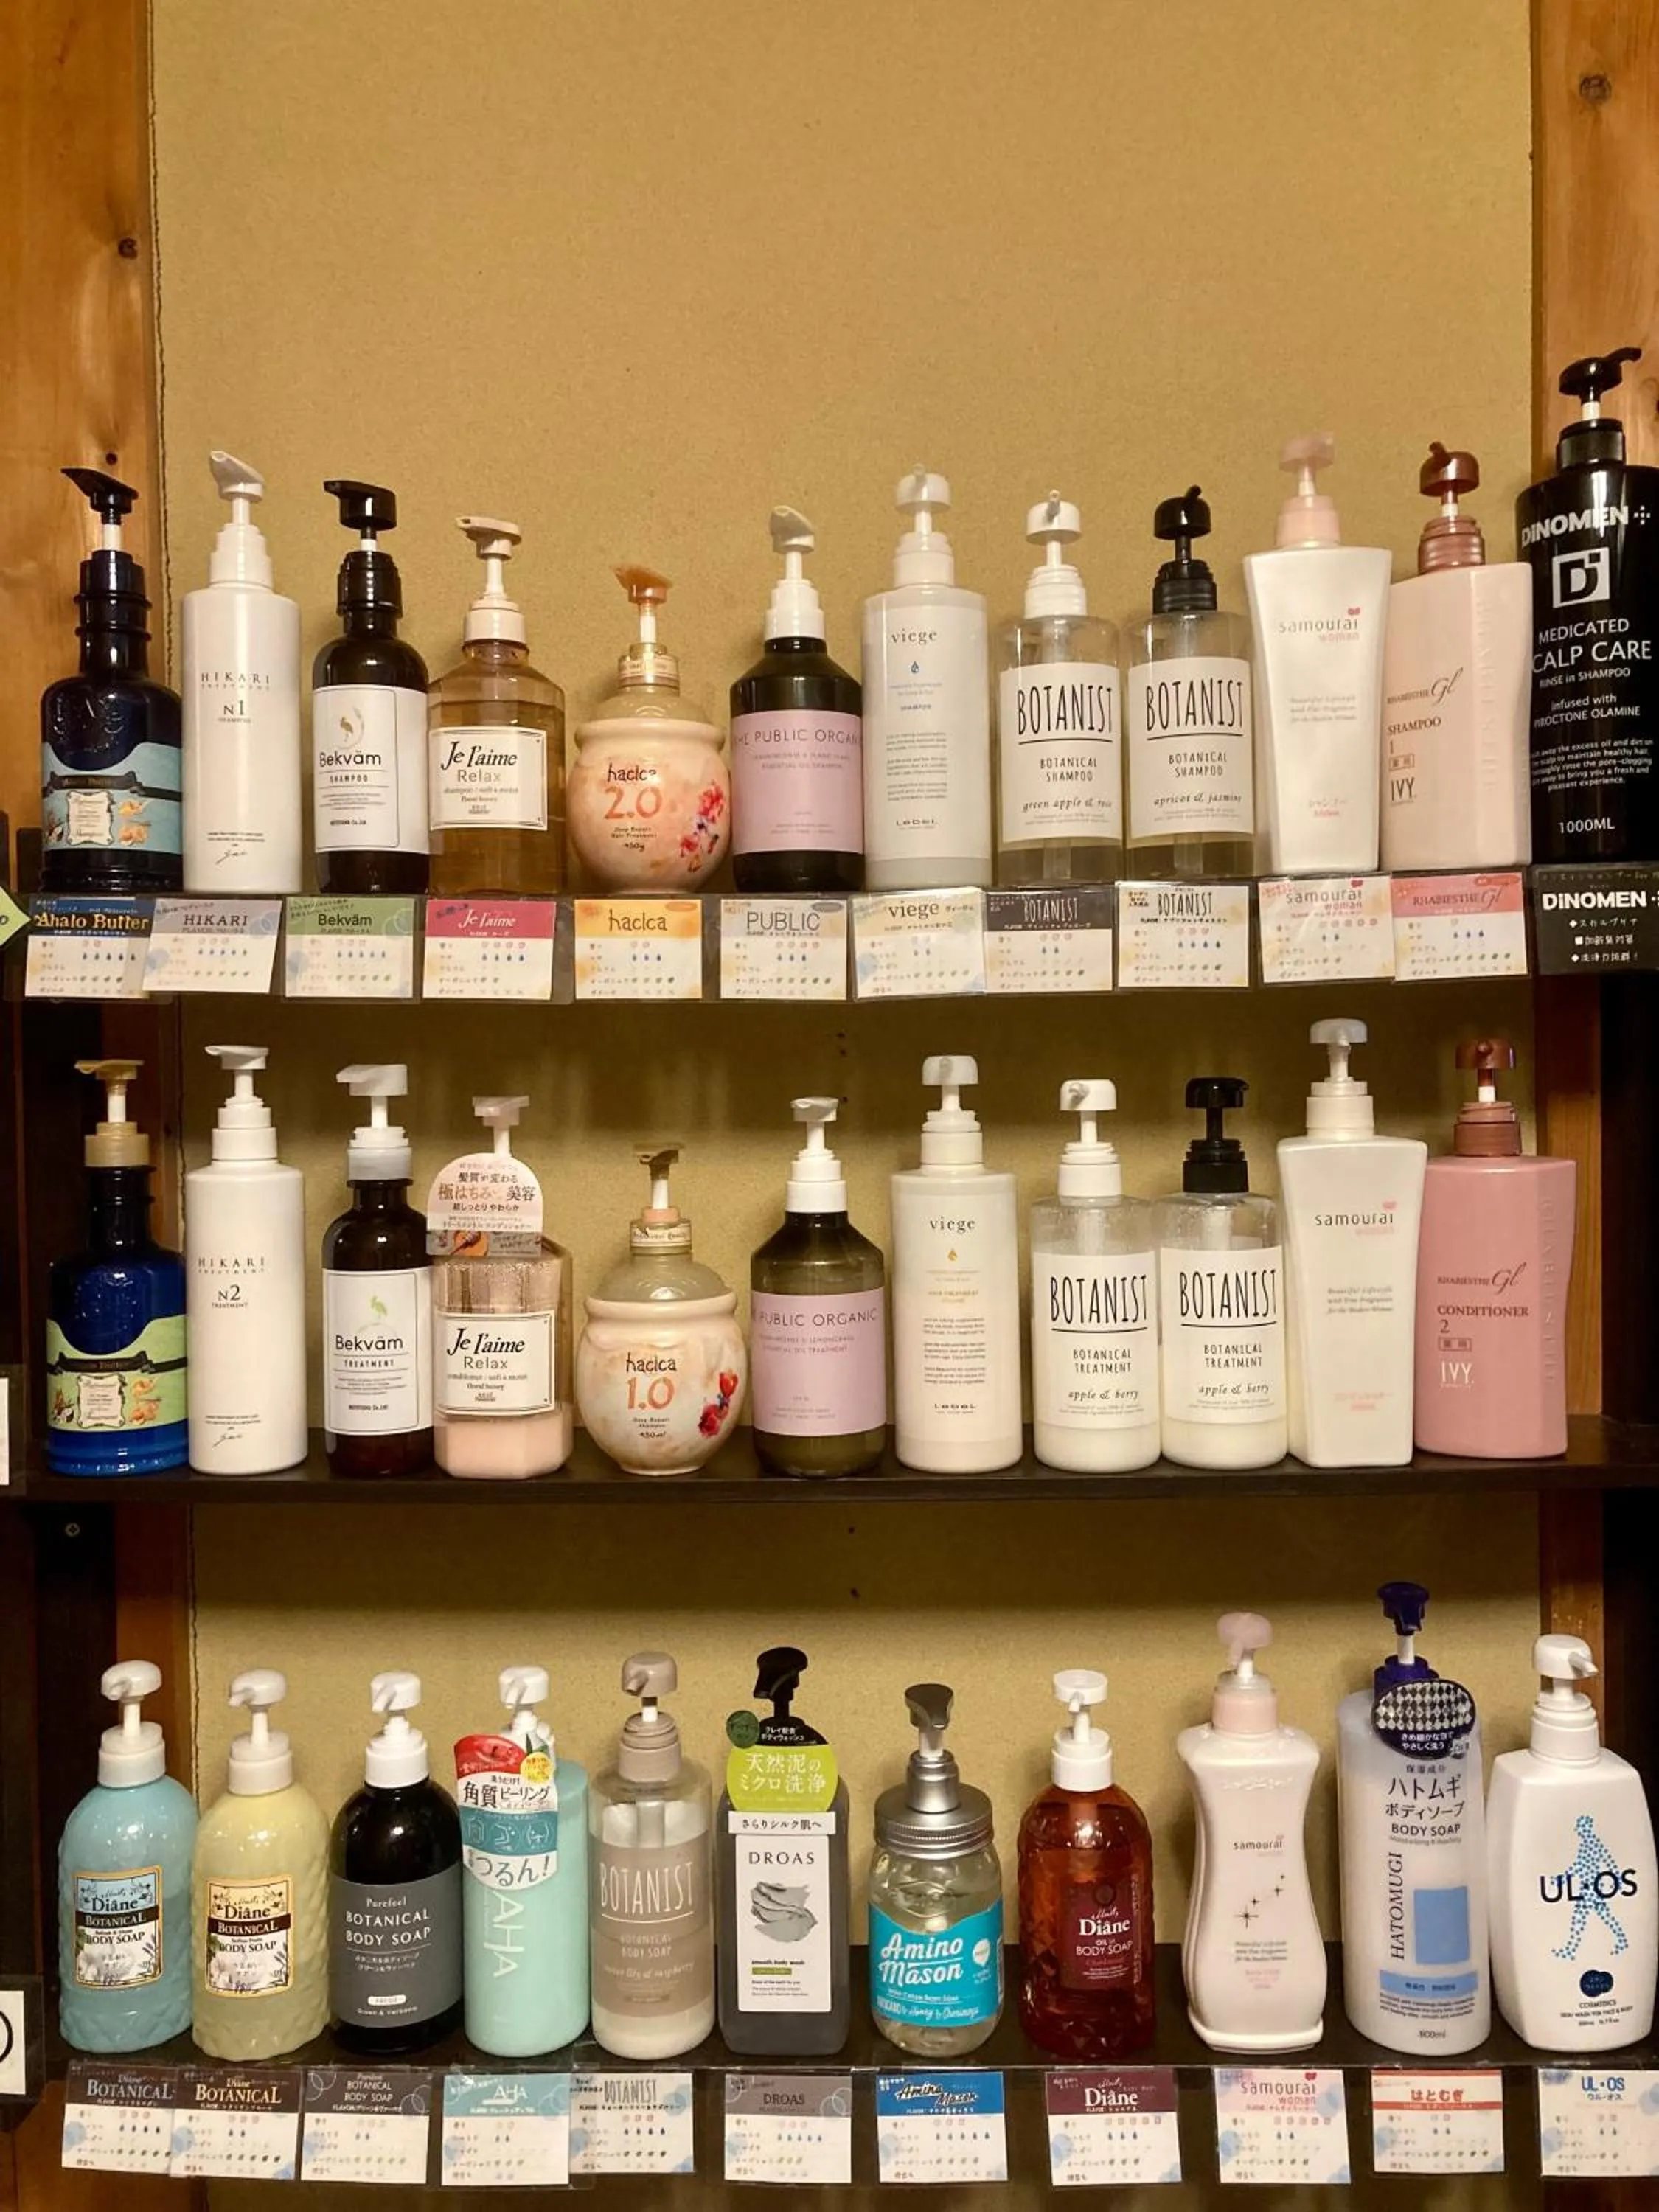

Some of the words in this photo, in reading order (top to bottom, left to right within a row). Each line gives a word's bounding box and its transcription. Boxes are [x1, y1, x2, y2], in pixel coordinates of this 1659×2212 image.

[1279, 618, 1359, 633] samourai
[1539, 618, 1630, 645] MEDICATED
[891, 627, 937, 645] viege
[1533, 644, 1583, 674] CALP
[1591, 640, 1652, 663] CARE
[201, 672, 270, 684] HIKARI
[1577, 667, 1631, 681] SHAMPOO
[1145, 678, 1243, 731] BOTANIST
[1592, 692, 1617, 705] with
[1017, 684, 1112, 735] BOTANIST
[1590, 705, 1641, 720] OLAMINE
[1387, 716, 1442, 736] SHAMPOO
[754, 728, 809, 744] PUBLIC
[1571, 742, 1599, 751] excess
[1613, 738, 1628, 747] and
[319, 750, 381, 768] Bekväm
[441, 741, 465, 771] Je
[1169, 751, 1228, 765] BOTANICAL
[1567, 752, 1601, 761] maintain
[1604, 747, 1632, 757] healthy
[1040, 757, 1097, 769] BOTANICAL
[1614, 765, 1635, 773] fresh
[456, 768, 502, 782] Relax
[1046, 771, 1093, 782] SHAMPOO
[1175, 765, 1224, 778] SHAMPOO
[603, 785, 663, 820] 2.0
[1053, 796, 1082, 810] apple
[1559, 816, 1615, 834] 1000ML
[1158, 892, 1212, 916] BOTANIST
[1285, 887, 1363, 905] samourai
[888, 900, 940, 919] viege
[1024, 897, 1077, 922] BOTANIST
[93, 914, 149, 930] Butter
[184, 914, 248, 926] HIKARI
[318, 914, 372, 926] Bekväm
[747, 911, 821, 931] PUBLIC
[929, 1216, 975, 1234] viege
[1315, 1213, 1394, 1226] samourai
[198, 1256, 265, 1268] HIKARI
[1050, 1275, 1147, 1324] BOTANIST
[1179, 1269, 1276, 1318] BOTANIST
[759, 1311, 805, 1326] PUBLIC
[812, 1307, 877, 1326] ORGANIC
[1437, 1304, 1529, 1318] CONDITIONER
[1439, 1318, 1450, 1334] 2
[335, 1335, 403, 1352] Bekväm
[446, 1327, 471, 1356] Je
[473, 1332, 525, 1354] l'aime
[1203, 1344, 1263, 1355] BOTANICAL
[463, 1356, 509, 1369] Relax
[1073, 1349, 1132, 1360] BOTANICAL
[1205, 1356, 1263, 1369] TREATMENT
[344, 1359, 394, 1368] TREATMENT
[1074, 1362, 1132, 1374] TREATMENT
[627, 1377, 675, 1410] 1.0
[1068, 1391, 1096, 1402] apple
[1114, 1390, 1140, 1399] berry
[1198, 1384, 1228, 1397] apple
[1246, 1382, 1270, 1394] berry
[745, 1752, 821, 1773] 天然泥の
[740, 1773, 827, 1793] ミクロ洗浄
[1388, 1773, 1461, 1801] ハトムギ
[463, 1781, 497, 1809] 角質
[501, 1785, 552, 1802] ピーリング
[1385, 1800, 1465, 1820] ボディソープ
[742, 1818, 823, 1831] さらりシルク肌へ
[1391, 1823, 1427, 1836] BODY
[1431, 1823, 1461, 1837] SOAP
[1233, 1840, 1283, 1851] samourai
[748, 1851, 815, 1865] DROAS
[599, 1862, 693, 1915] BOTANIST
[91, 1896, 139, 1912] Diâne
[224, 1905, 271, 1919] Diâne
[1388, 1851, 1405, 1961] HATOMUGI
[85, 1912, 146, 1927] BOTANICAL
[346, 1907, 431, 1927] BOTANICAL
[218, 1920, 278, 1933] BOTANICAL
[482, 1889, 526, 1979] AHA
[1079, 1918, 1130, 1935] Diâne
[86, 1935, 114, 1945] BODY
[116, 1931, 145, 1944] SOAP
[346, 1930, 384, 1946] BODY
[392, 1927, 431, 1946] SOAP
[219, 1943, 247, 1953] BODY
[248, 1940, 276, 1952] SOAP
[622, 1947, 644, 1958] BODY
[649, 1946, 672, 1958] SOAP
[880, 1933, 964, 1959] Amino
[1076, 1945, 1105, 1956] BODY
[1107, 1940, 1133, 1955] SOAP
[87, 2079, 173, 2100] BOTANICAL
[195, 2083, 282, 2104] BOTANICAL
[347, 2081, 392, 2091] BOTANICAL
[493, 2084, 529, 2101] AHA
[604, 2079, 657, 2103] BOTANIST
[1240, 2081, 1316, 2096] samourai
[344, 2092, 366, 2101] BODY
[371, 2092, 393, 2102] SOAP
[763, 2093, 806, 2106] DROAS
[1085, 2087, 1138, 2107] Diâne
[1278, 2096, 1316, 2106] woman
[1410, 2088, 1465, 2102] はとむぎ
